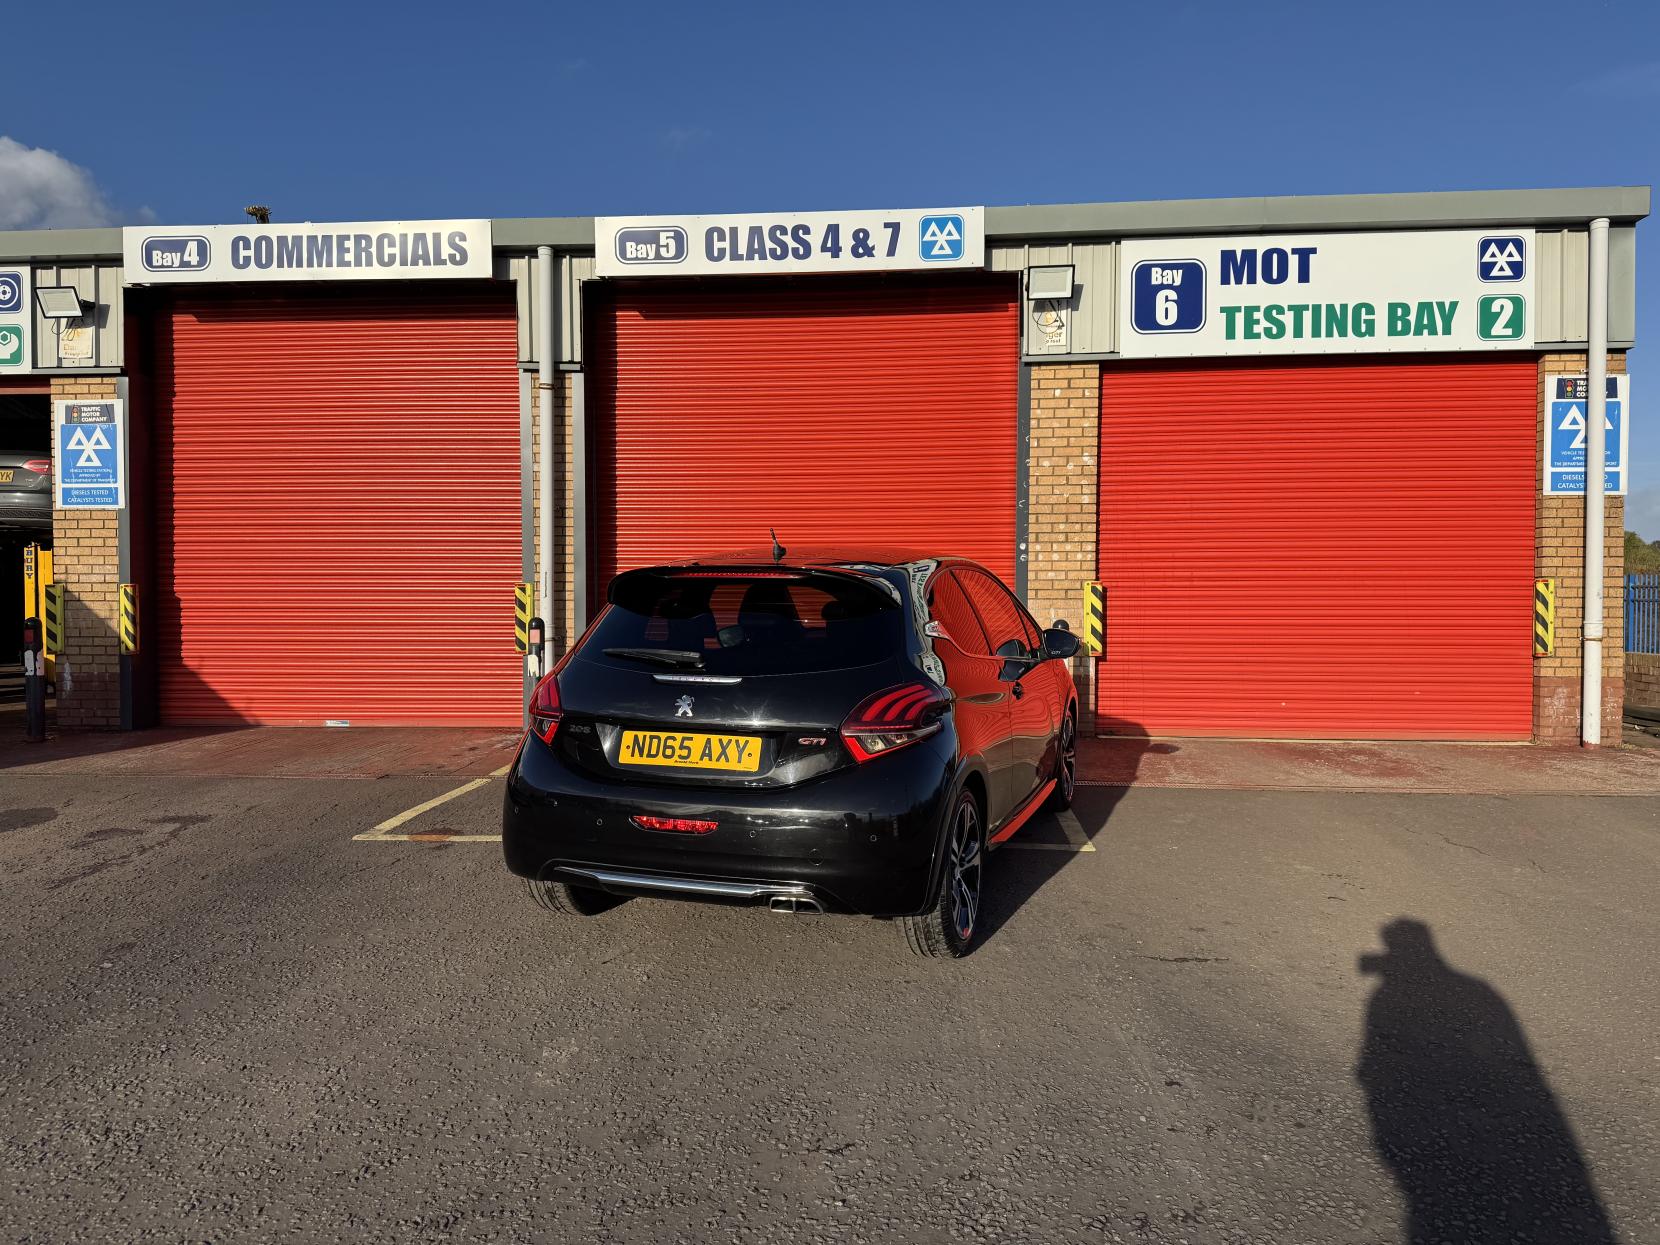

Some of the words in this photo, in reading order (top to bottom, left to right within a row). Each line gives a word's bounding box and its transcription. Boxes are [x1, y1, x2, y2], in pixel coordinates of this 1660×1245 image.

[151, 250, 181, 267] Bay
[183, 240, 200, 266] 4
[230, 231, 468, 270] COMMERCIALS
[625, 241, 656, 260] Bay
[659, 231, 676, 258] 5
[704, 223, 812, 262] CLASS
[820, 223, 842, 259] 4
[850, 227, 875, 258] &
[883, 221, 901, 257] 7
[1151, 267, 1183, 286] Bay
[1219, 247, 1318, 286] MOT
[1155, 289, 1178, 326] 6
[1219, 302, 1376, 341] TESTING
[1387, 300, 1460, 338] BAY
[1490, 298, 1515, 336] 2
[630, 734, 694, 761] ND65
[699, 737, 750, 764] AXY
